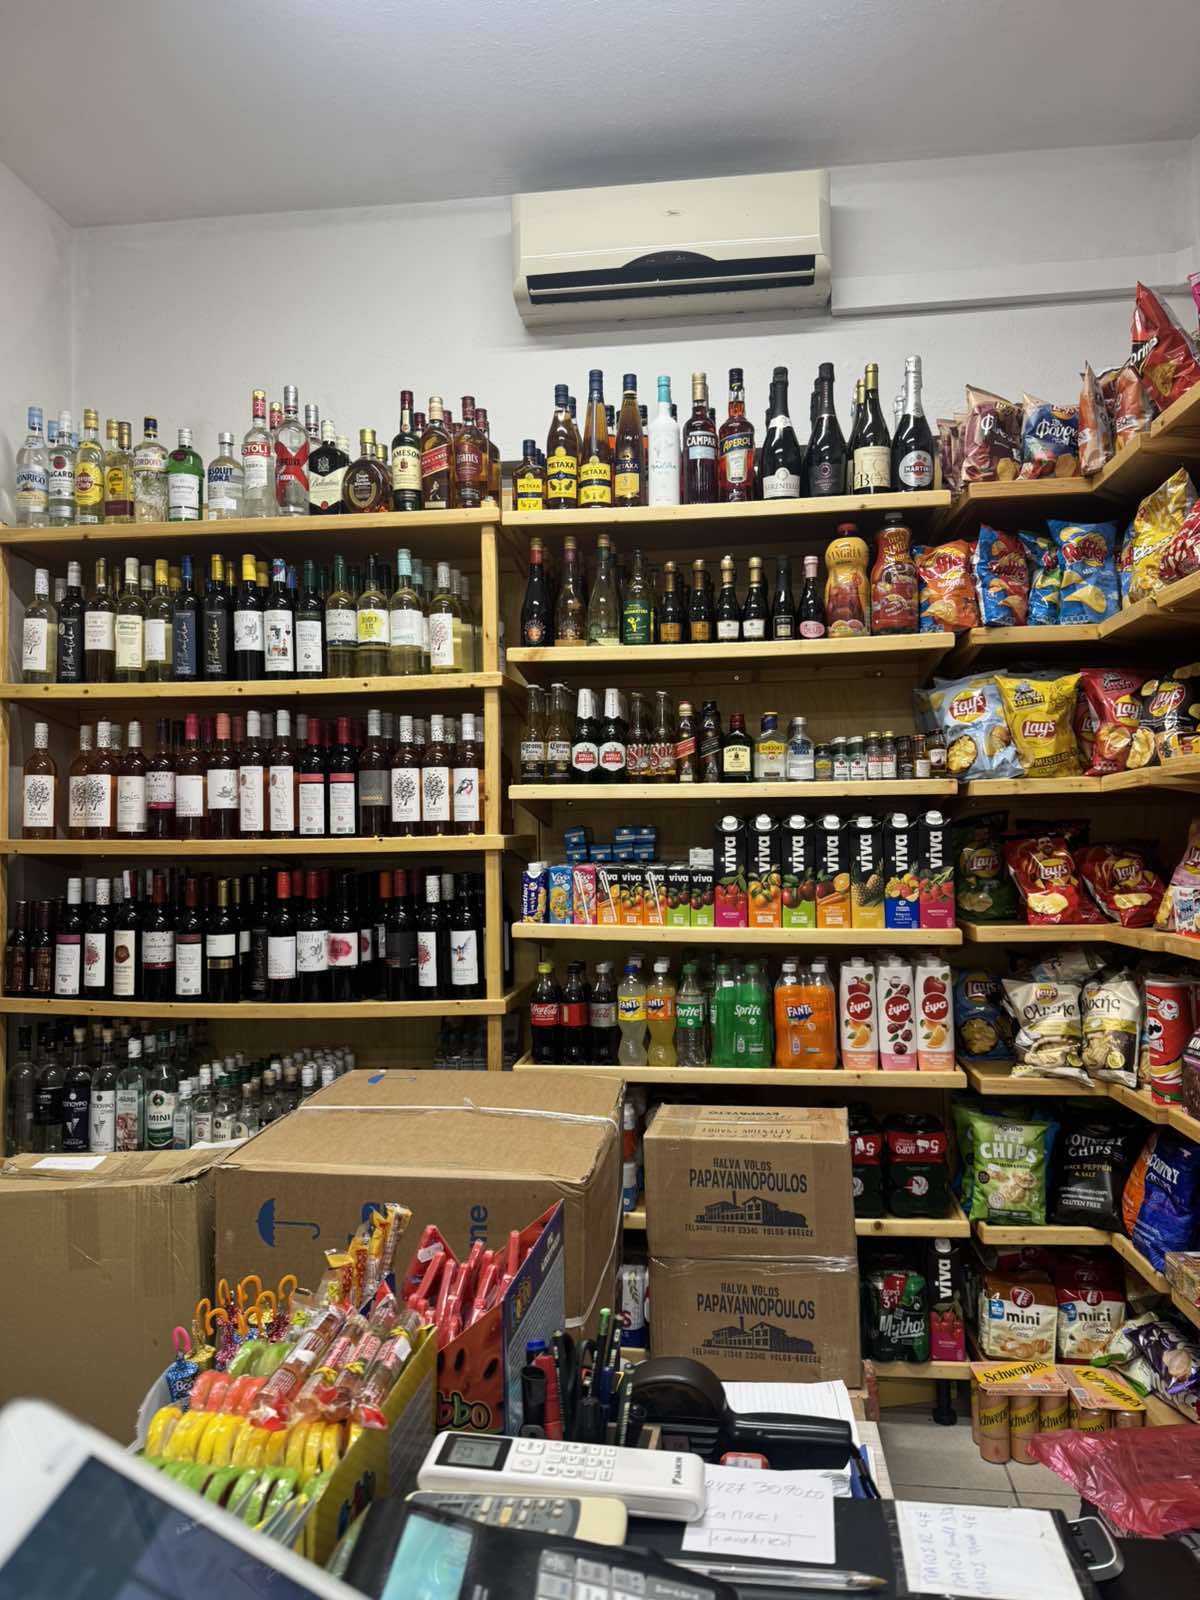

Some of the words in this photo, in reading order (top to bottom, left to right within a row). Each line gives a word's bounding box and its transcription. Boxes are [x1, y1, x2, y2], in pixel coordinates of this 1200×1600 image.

[949, 695, 986, 717] Lay's
[1024, 720, 1056, 739] Lay's
[721, 836, 737, 874] viva
[754, 835, 771, 873] viva
[788, 835, 805, 874] viva
[822, 835, 840, 874] viva
[856, 834, 873, 873] viva
[891, 834, 908, 873] viva
[925, 831, 943, 870] viva
[621, 873, 642, 882] viva
[669, 873, 689, 882] viva
[692, 874, 713, 883] viva
[734, 1004, 762, 1018] Sprite
[979, 1142, 1038, 1164] CHIPS
[1068, 1145, 1112, 1157] CHIPS
[712, 1157, 740, 1169] HALVA
[744, 1159, 772, 1172] VOLOS
[688, 1168, 808, 1193] PAPAYANNOPOULOS
[720, 1281, 748, 1295] HALVA
[751, 1284, 780, 1297] VOLOS
[935, 1259, 953, 1299] viva
[696, 1293, 816, 1320] PAPAYANNOPOULOS
[1006, 1309, 1040, 1326] mini
[1078, 1307, 1112, 1322] mini
[879, 1314, 925, 1344] Mythos
[982, 1360, 1049, 1383] Schweppes
